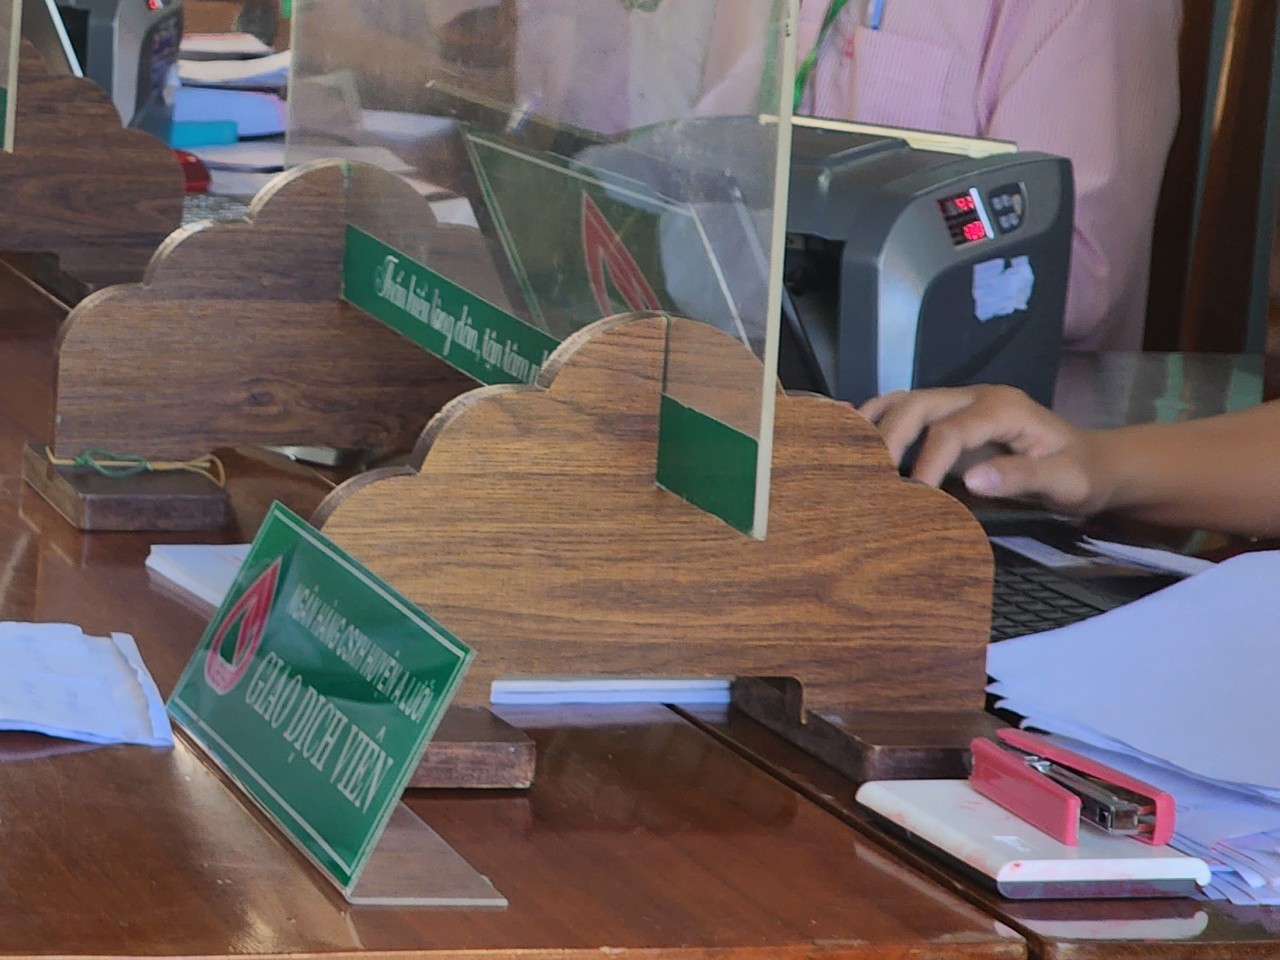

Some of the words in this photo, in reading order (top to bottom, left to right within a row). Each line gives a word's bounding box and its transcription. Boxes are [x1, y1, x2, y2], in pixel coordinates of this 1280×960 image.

[245, 651, 303, 729] GIAO
[283, 685, 349, 772] DỊCH
[330, 725, 395, 815] VIÊN
